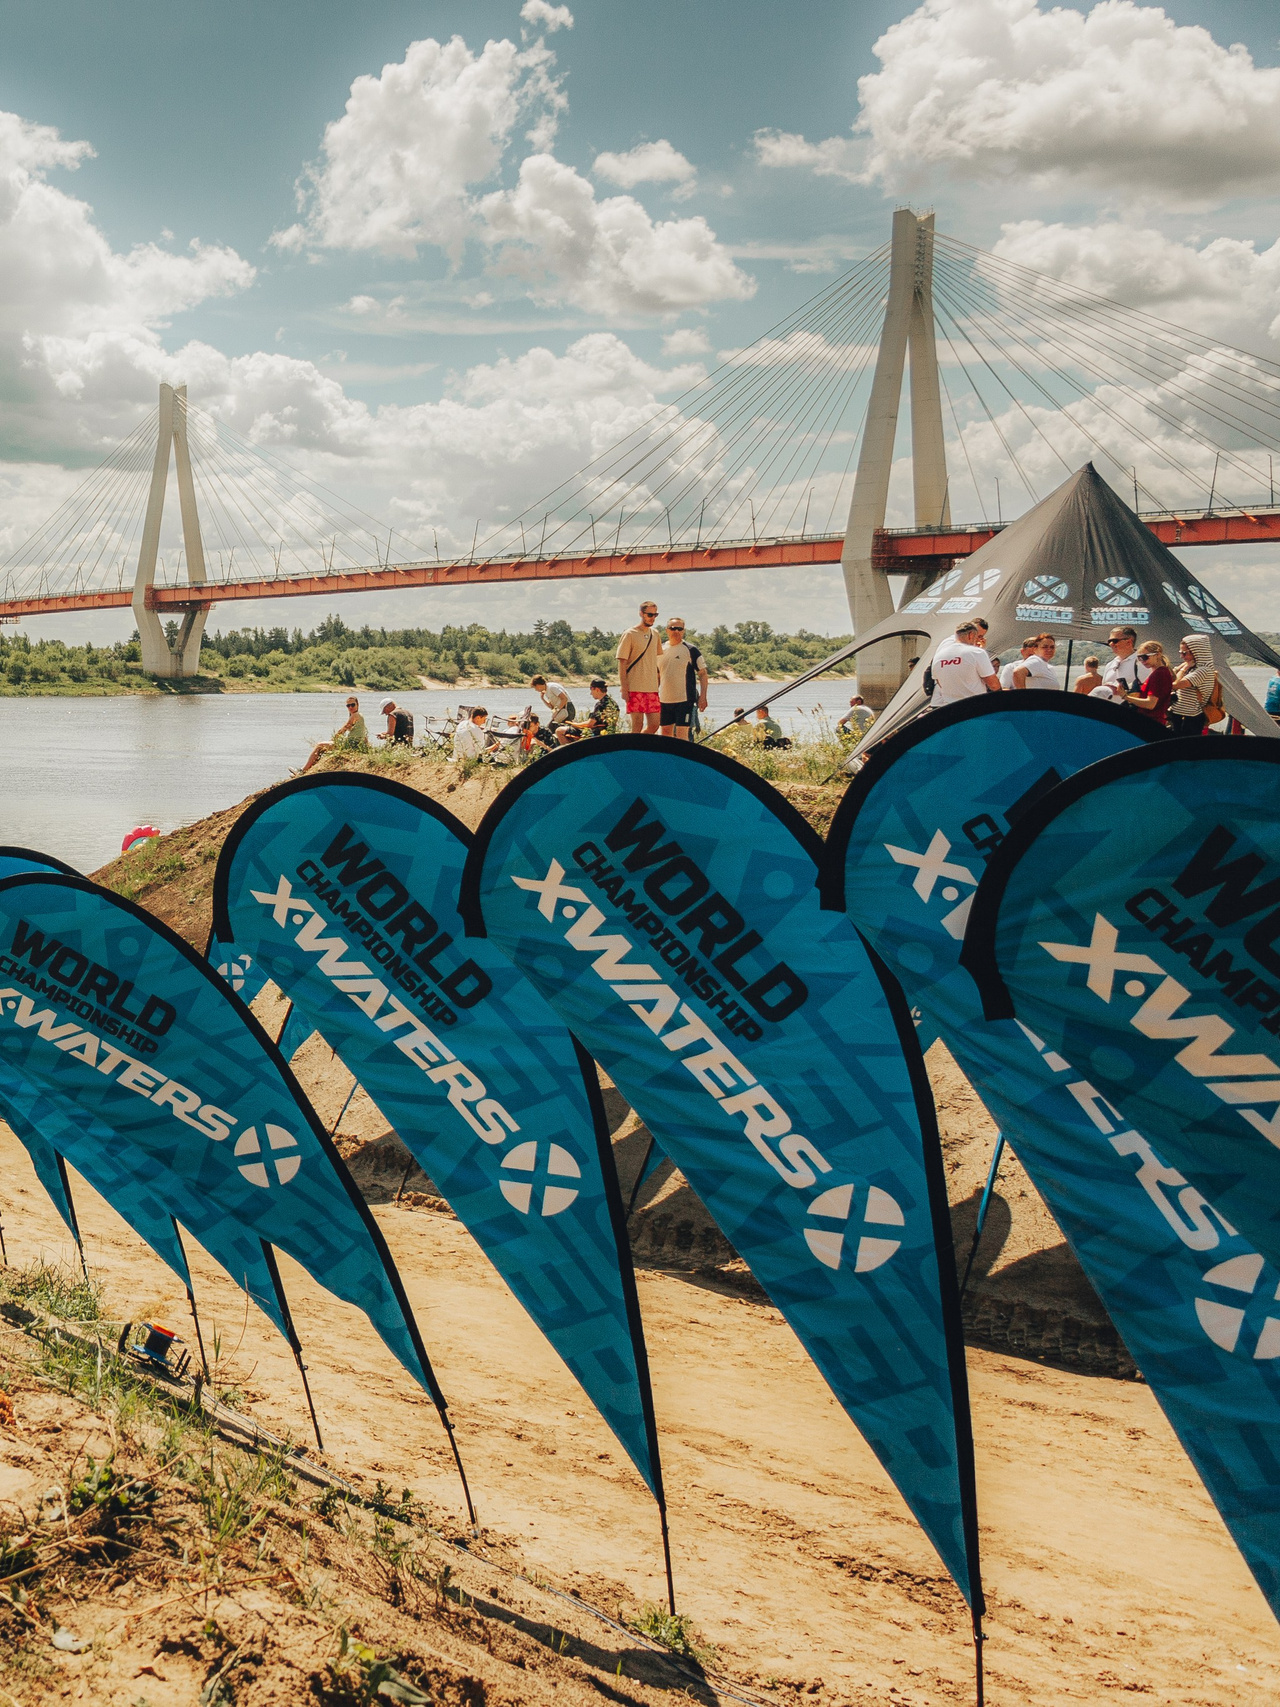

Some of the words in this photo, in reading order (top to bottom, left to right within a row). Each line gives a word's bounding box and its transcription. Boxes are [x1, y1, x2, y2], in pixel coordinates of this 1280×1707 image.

[1015, 608, 1073, 620] WORLD
[1090, 612, 1150, 621] WORLD
[10, 919, 177, 1037] WORLD
[296, 859, 458, 1029] CHAMPIONSHIP
[320, 823, 493, 1010] WORLD
[572, 841, 763, 1042] CHAMPIONSHIP
[603, 796, 809, 1022] WORLD
